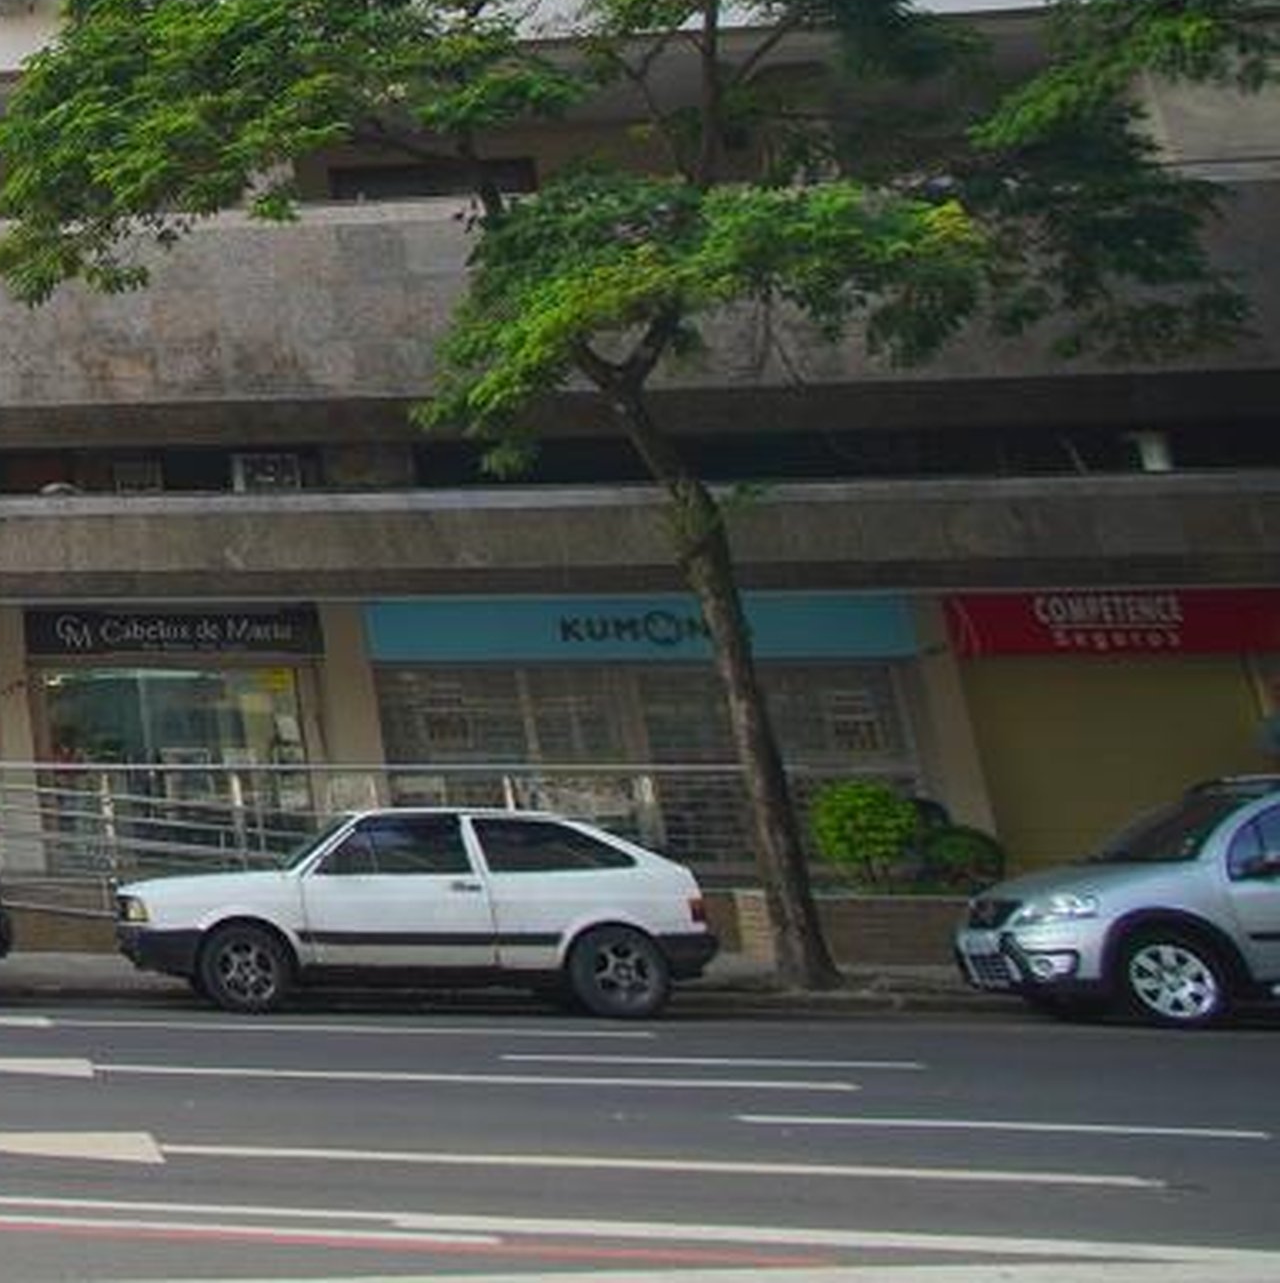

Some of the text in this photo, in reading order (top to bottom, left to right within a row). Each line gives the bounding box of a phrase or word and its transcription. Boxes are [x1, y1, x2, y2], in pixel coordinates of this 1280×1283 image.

[1033, 593, 1184, 625] COMPETENCE
[560, 610, 712, 646] KUMON
[1052, 630, 1182, 651] Seguros
